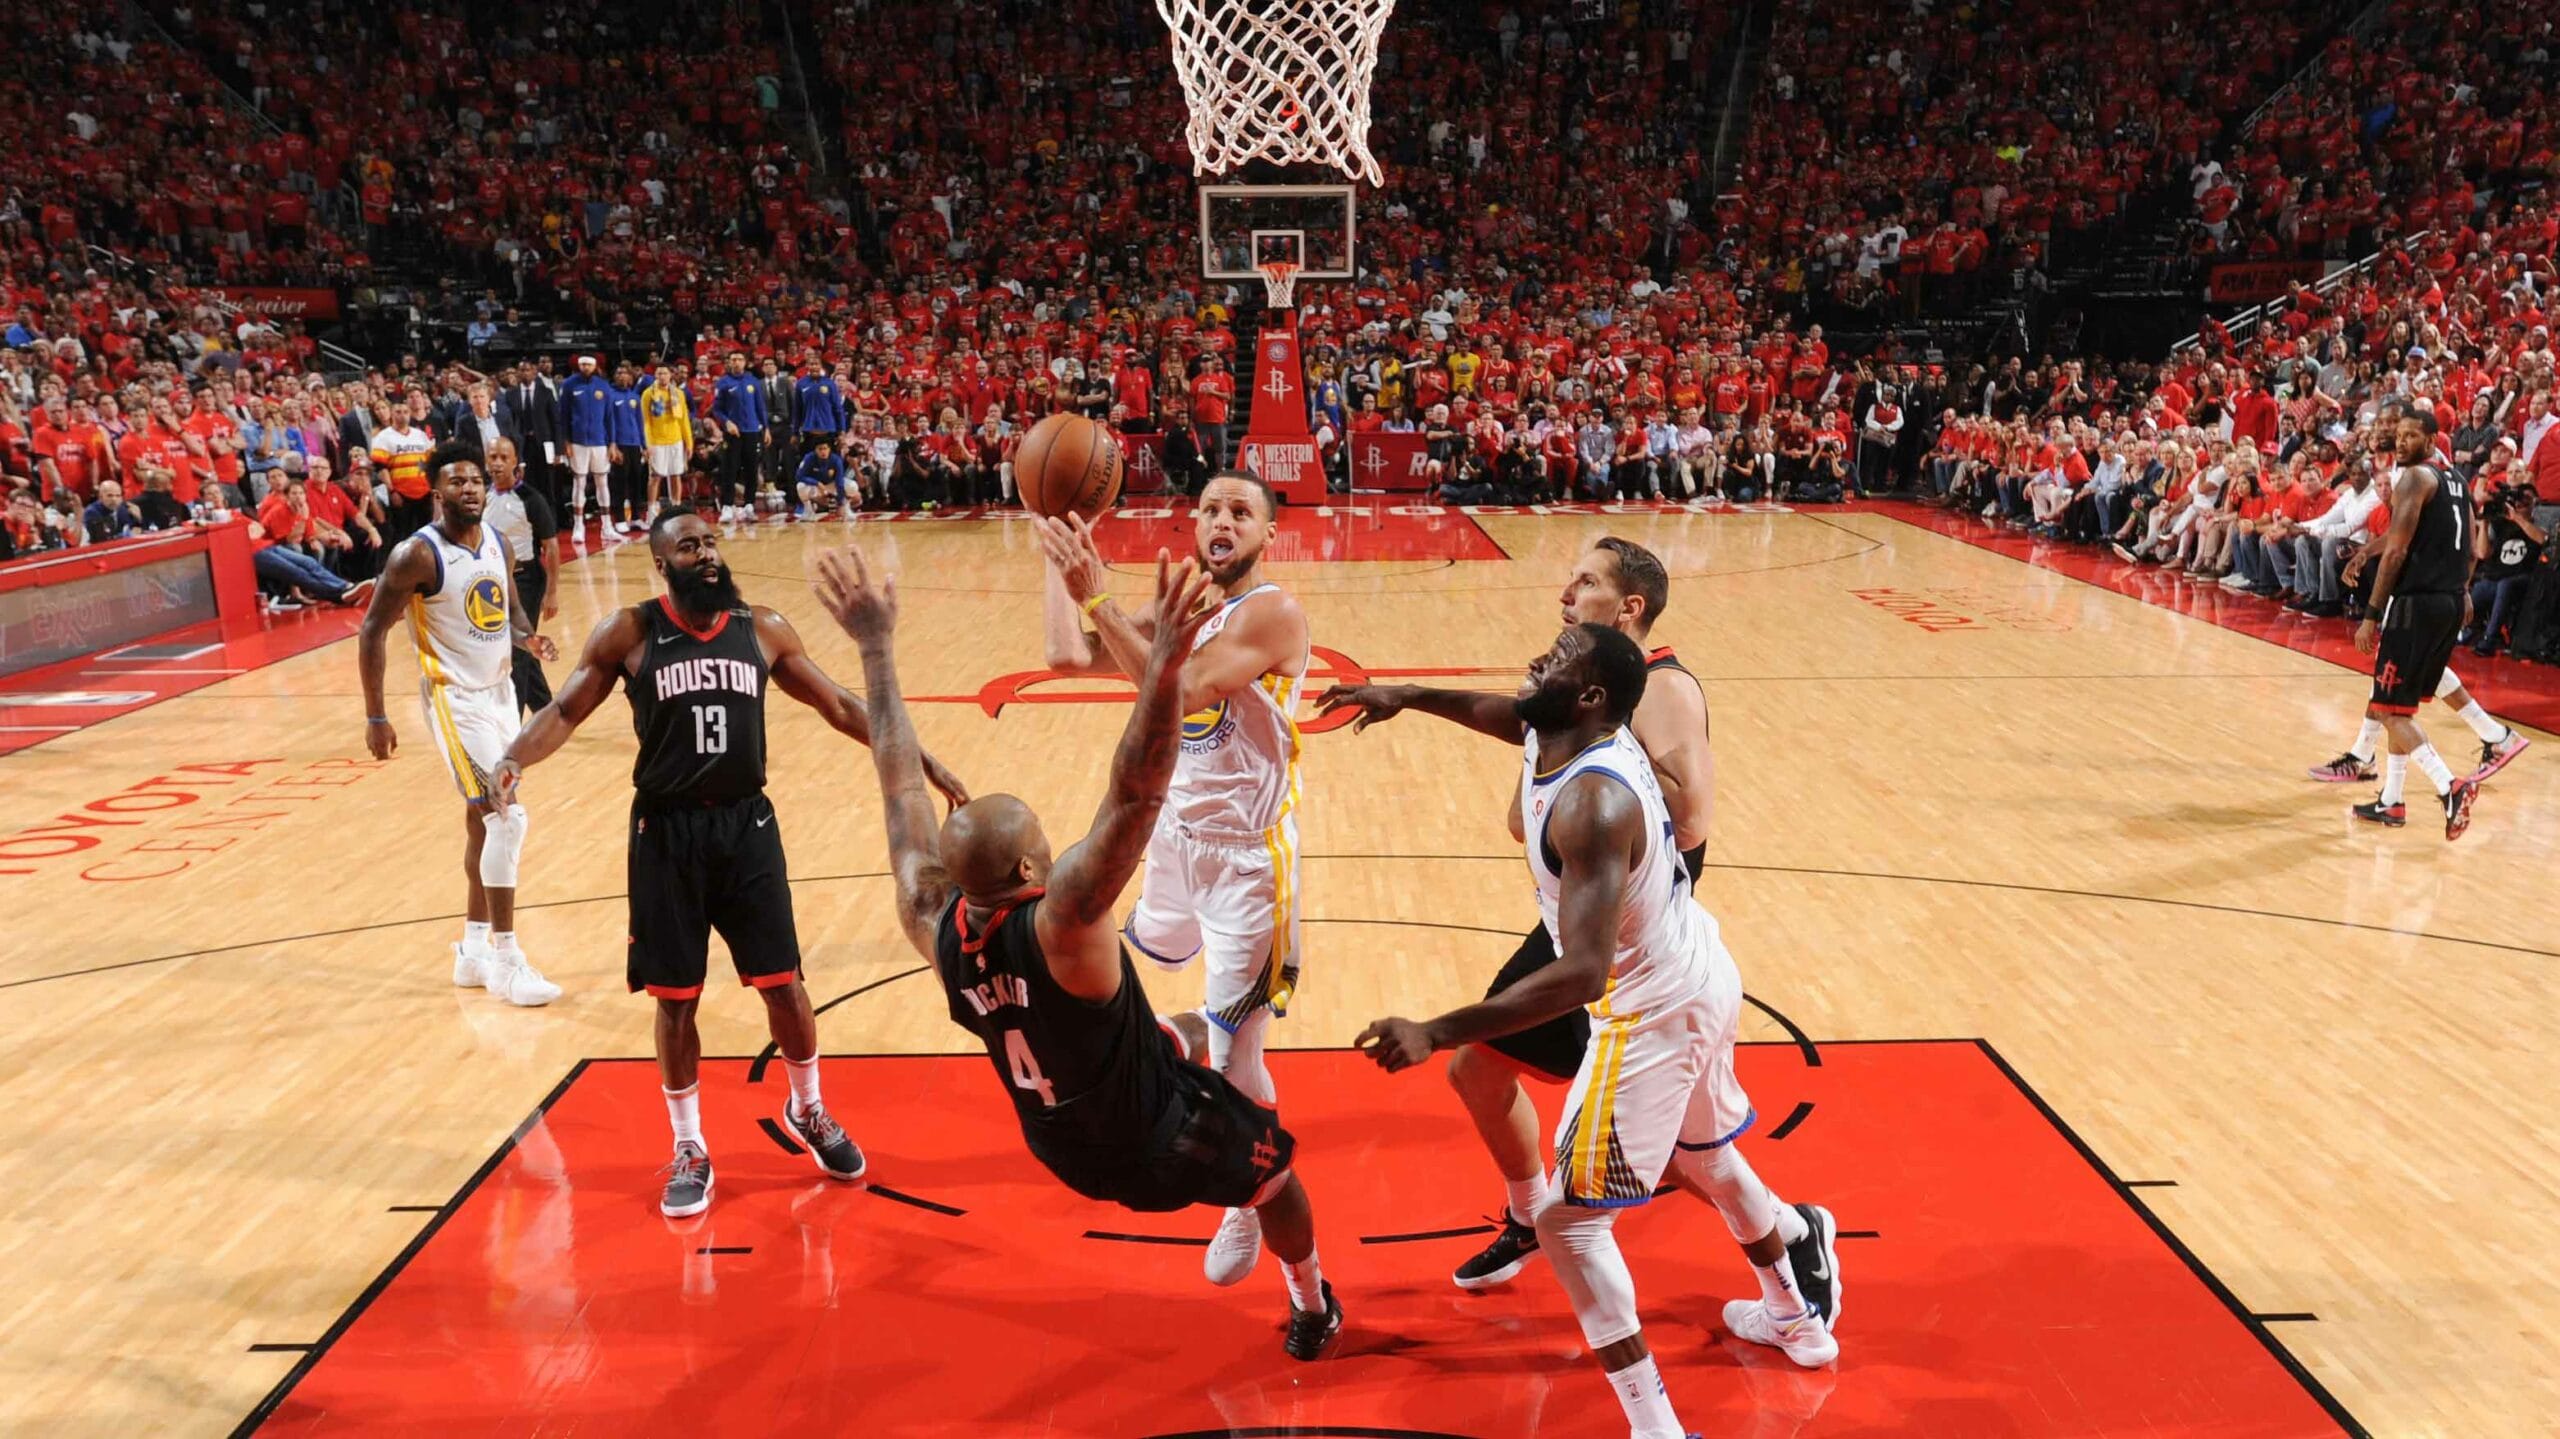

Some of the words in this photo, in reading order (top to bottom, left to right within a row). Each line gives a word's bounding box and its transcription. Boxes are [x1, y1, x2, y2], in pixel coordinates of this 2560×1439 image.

[1264, 444, 1314, 463] WESTERN
[1265, 463, 1301, 481] FINALS
[2452, 504, 2463, 551] 1
[491, 586, 501, 603] 2
[1845, 587, 1990, 632] TOYOTA
[655, 658, 758, 701] HOUSTON
[691, 705, 728, 754] 13
[1180, 719, 1237, 756] RRIORS
[79, 757, 401, 882] CENTER
[1004, 1029, 1057, 1106] 4
